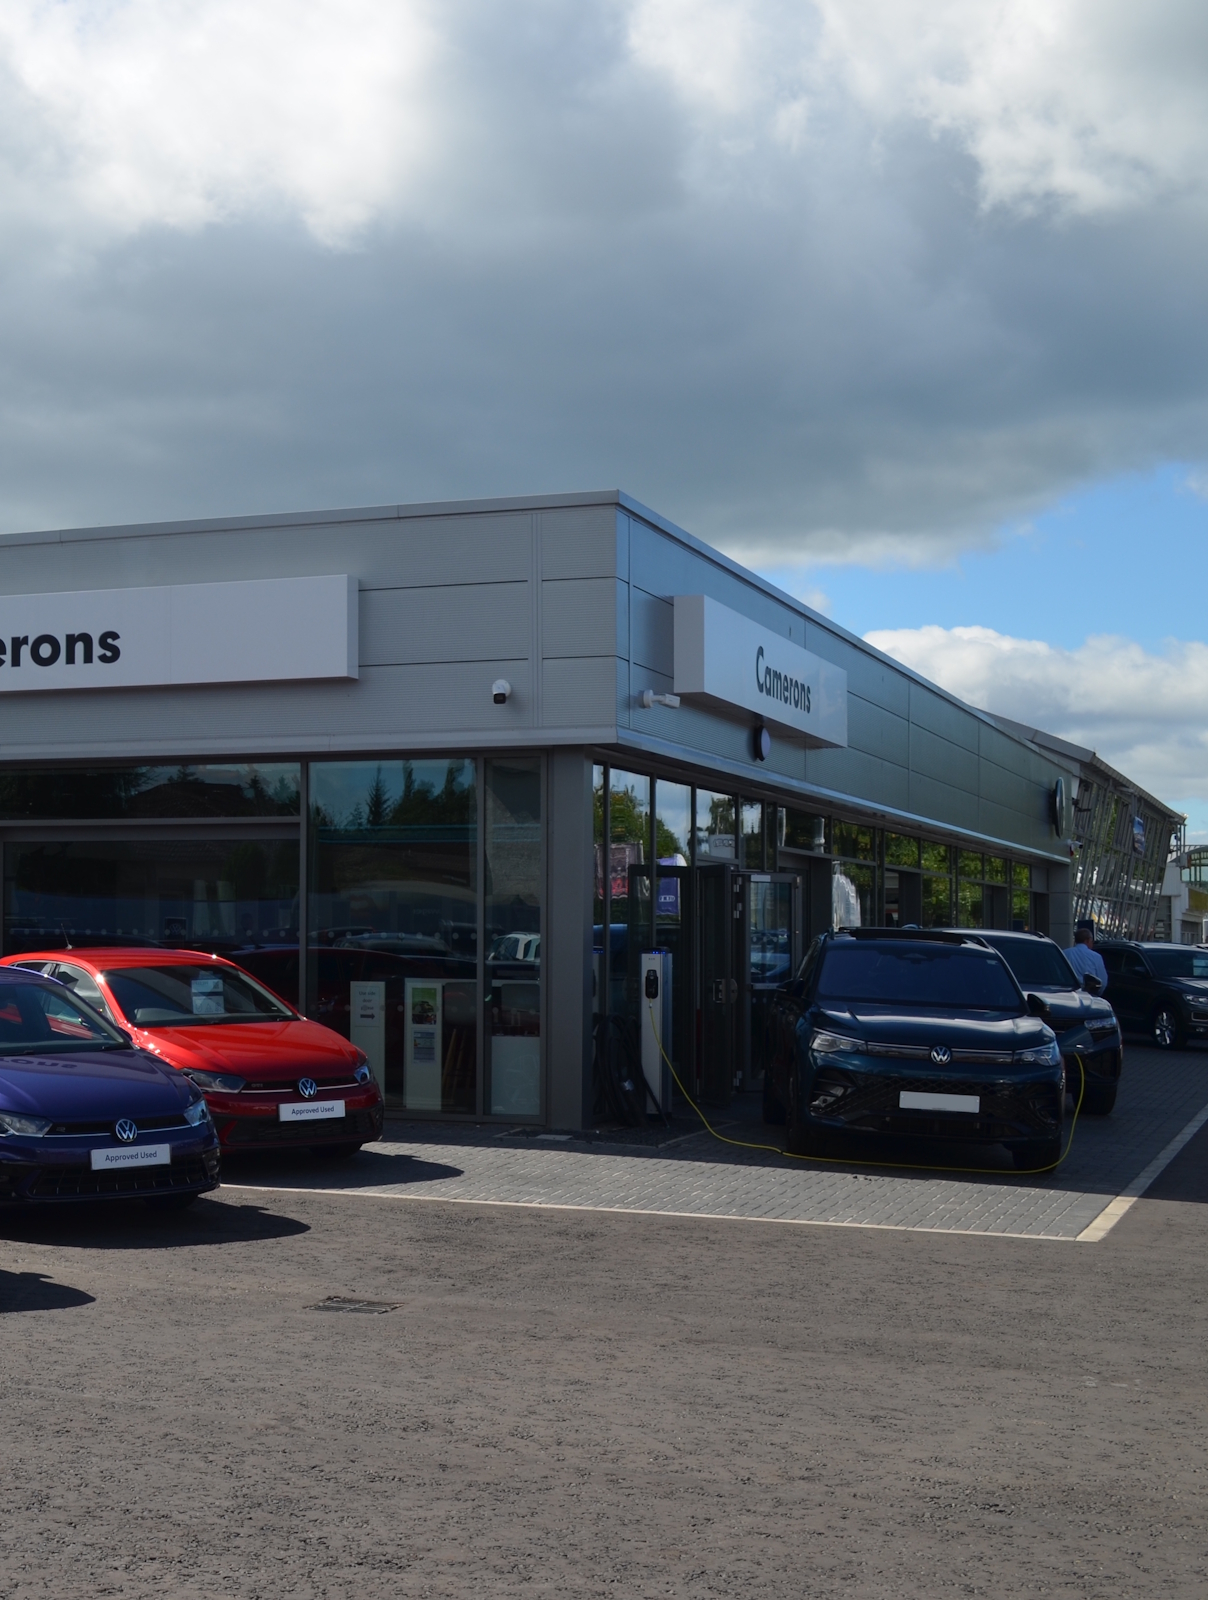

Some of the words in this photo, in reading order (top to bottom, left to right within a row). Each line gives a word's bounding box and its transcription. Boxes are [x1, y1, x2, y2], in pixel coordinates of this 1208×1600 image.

[755, 645, 812, 714] Camerons
[292, 1106, 319, 1116] Approved
[320, 1105, 335, 1113] Used
[105, 1152, 139, 1163] Approved
[140, 1150, 158, 1159] Used
